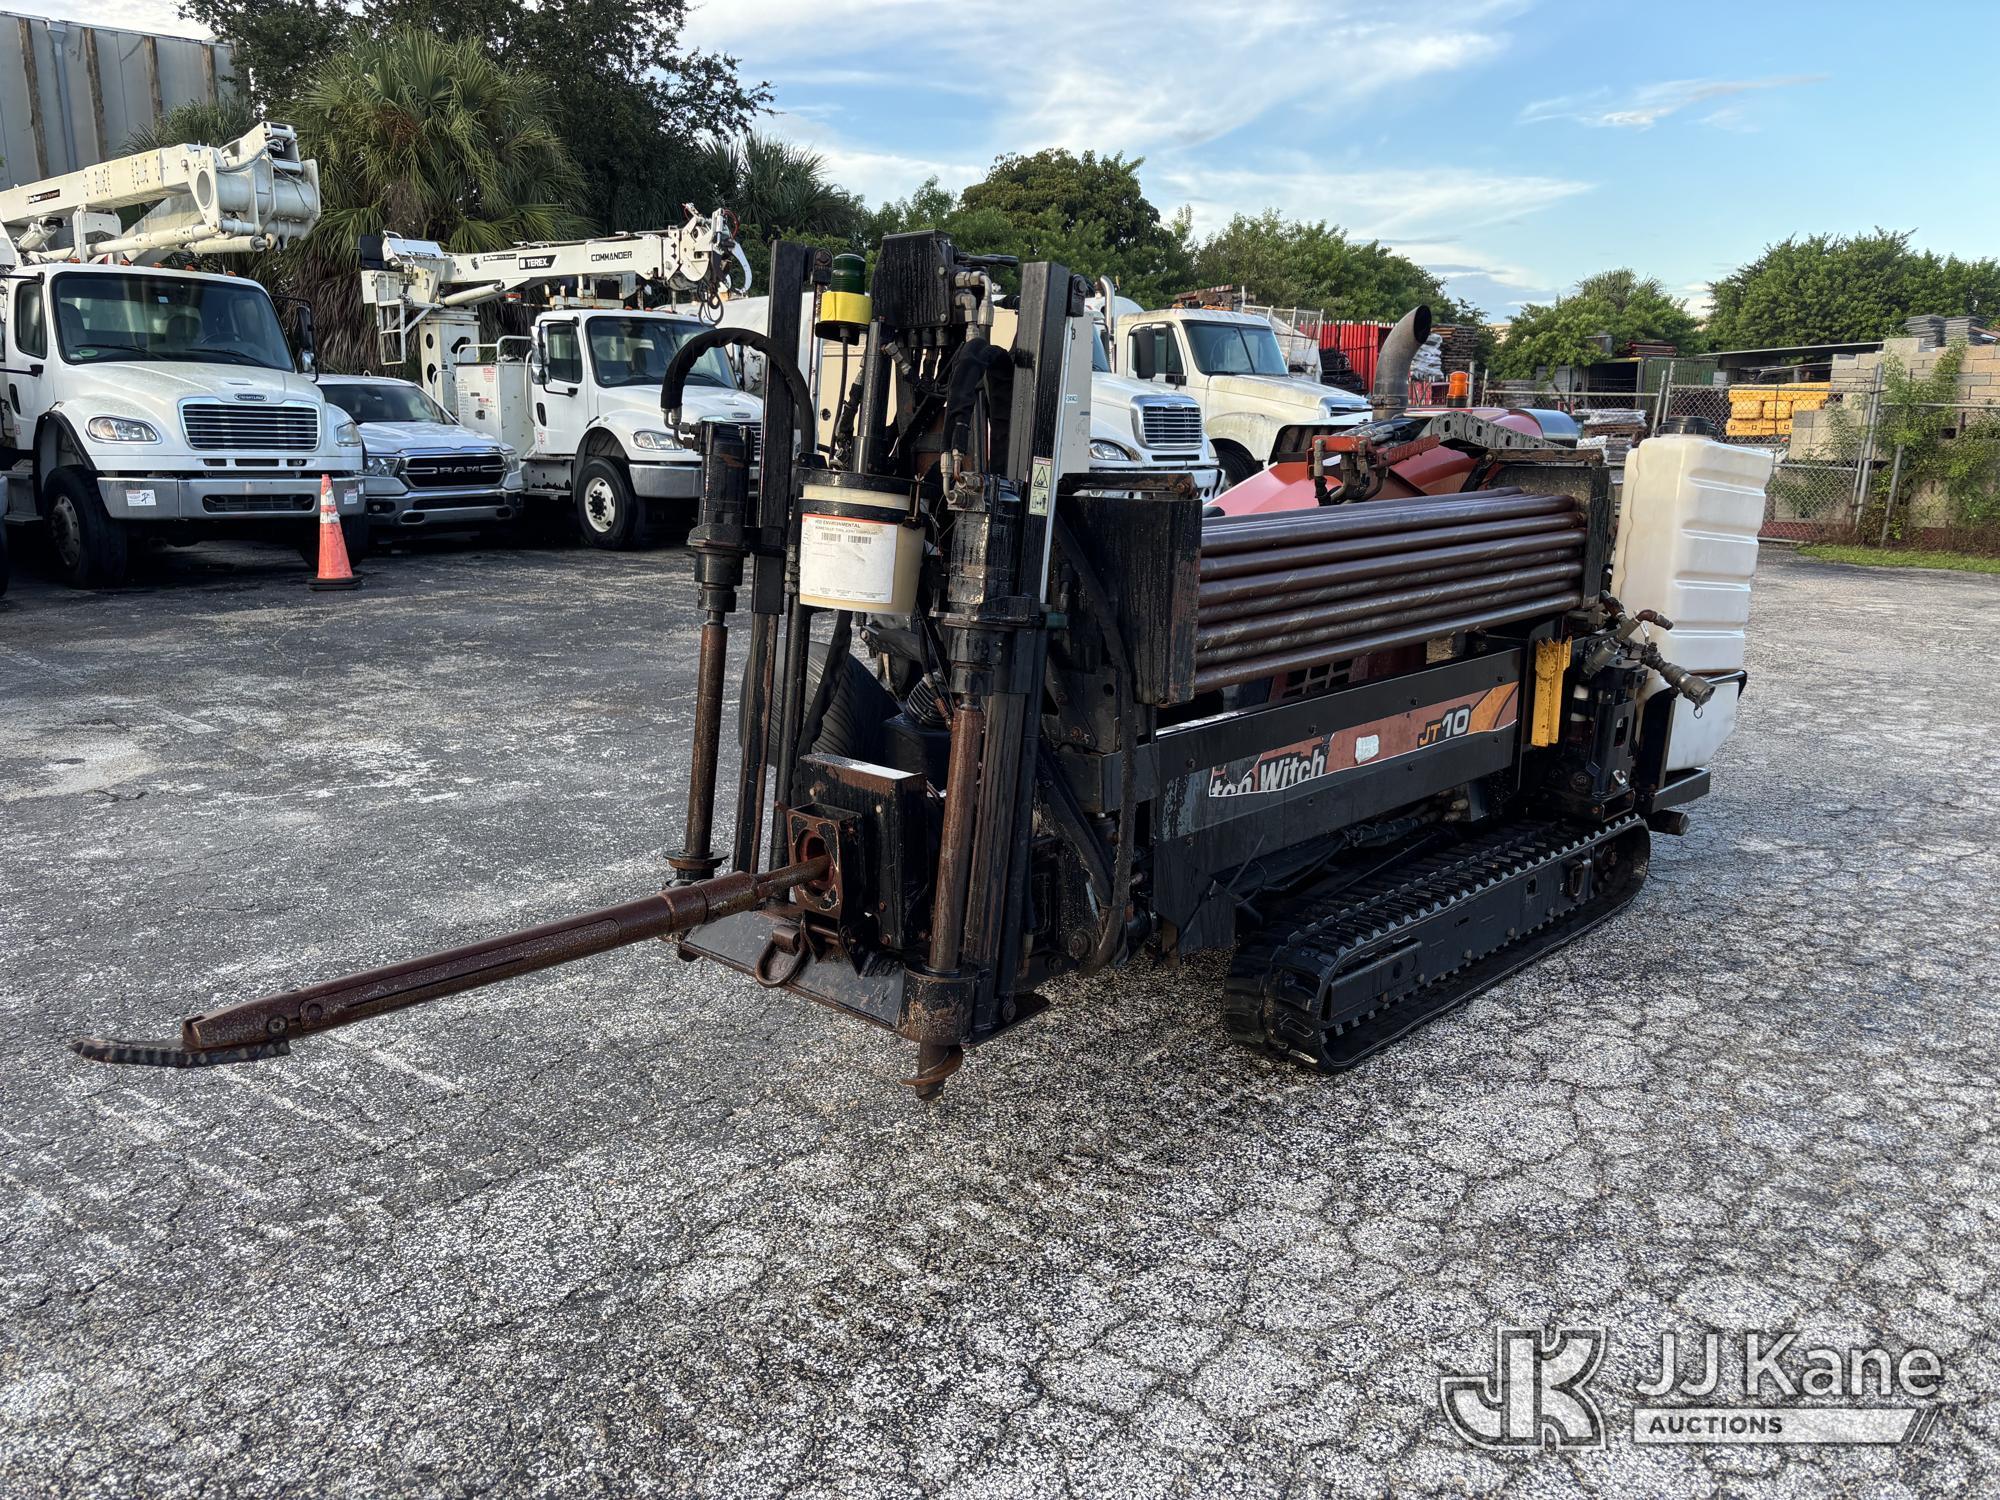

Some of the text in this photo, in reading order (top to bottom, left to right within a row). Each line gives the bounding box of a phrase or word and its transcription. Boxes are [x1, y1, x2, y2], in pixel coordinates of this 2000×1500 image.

[591, 251, 633, 262] COMMANDER
[526, 257, 549, 268] TEREX
[440, 466, 479, 474] RAM
[1419, 707, 1470, 746] JT10
[1260, 748, 1325, 791] Witch
